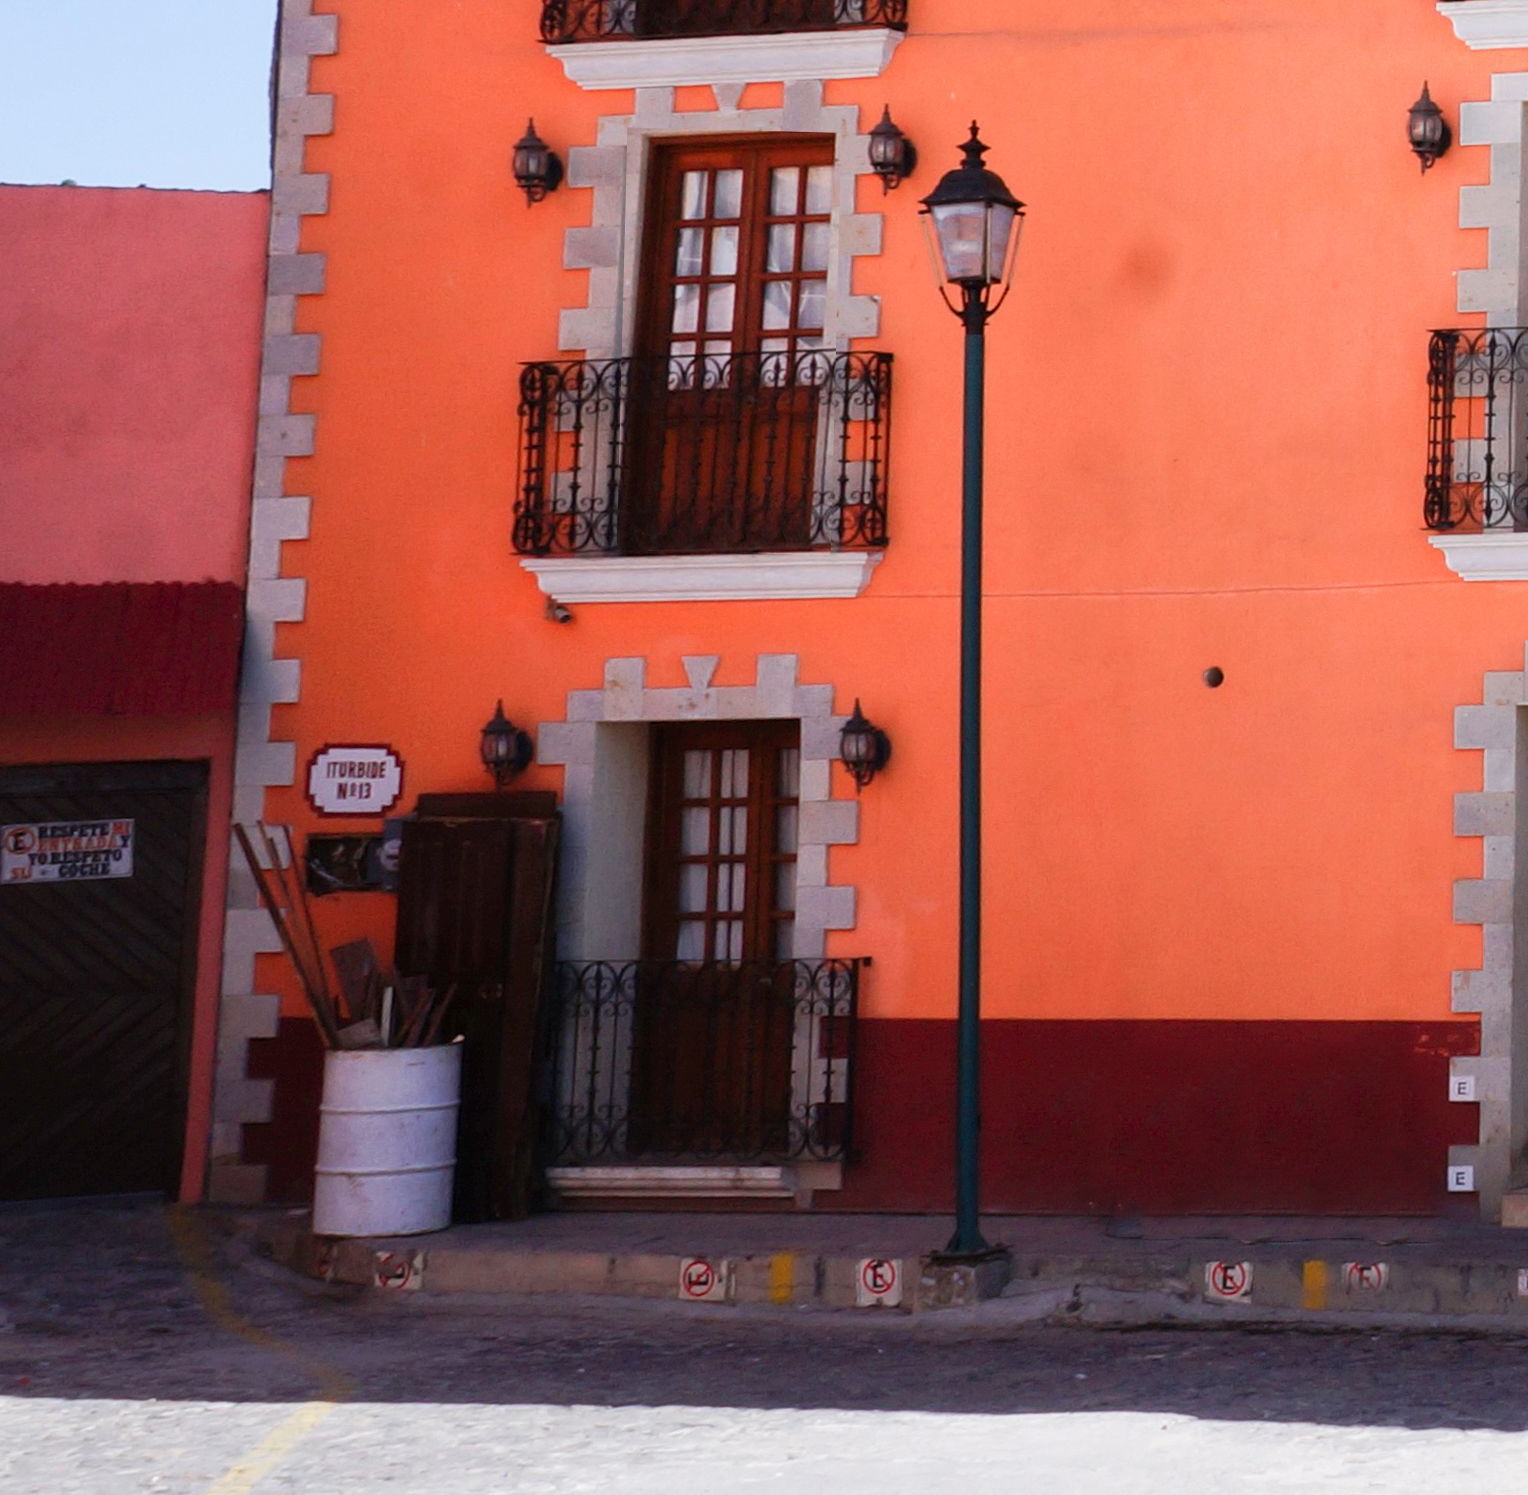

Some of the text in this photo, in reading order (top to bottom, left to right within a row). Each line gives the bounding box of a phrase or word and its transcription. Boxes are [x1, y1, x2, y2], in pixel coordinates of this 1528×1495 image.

[326, 761, 387, 779] ITURBIDE
[38, 824, 110, 839] RESPETE
[38, 835, 130, 853] ENTRADA Y
[28, 849, 122, 866] YO RESPETO
[58, 863, 110, 878] COCHE
[1457, 1081, 1467, 1096] E
[1455, 1171, 1466, 1186] E
